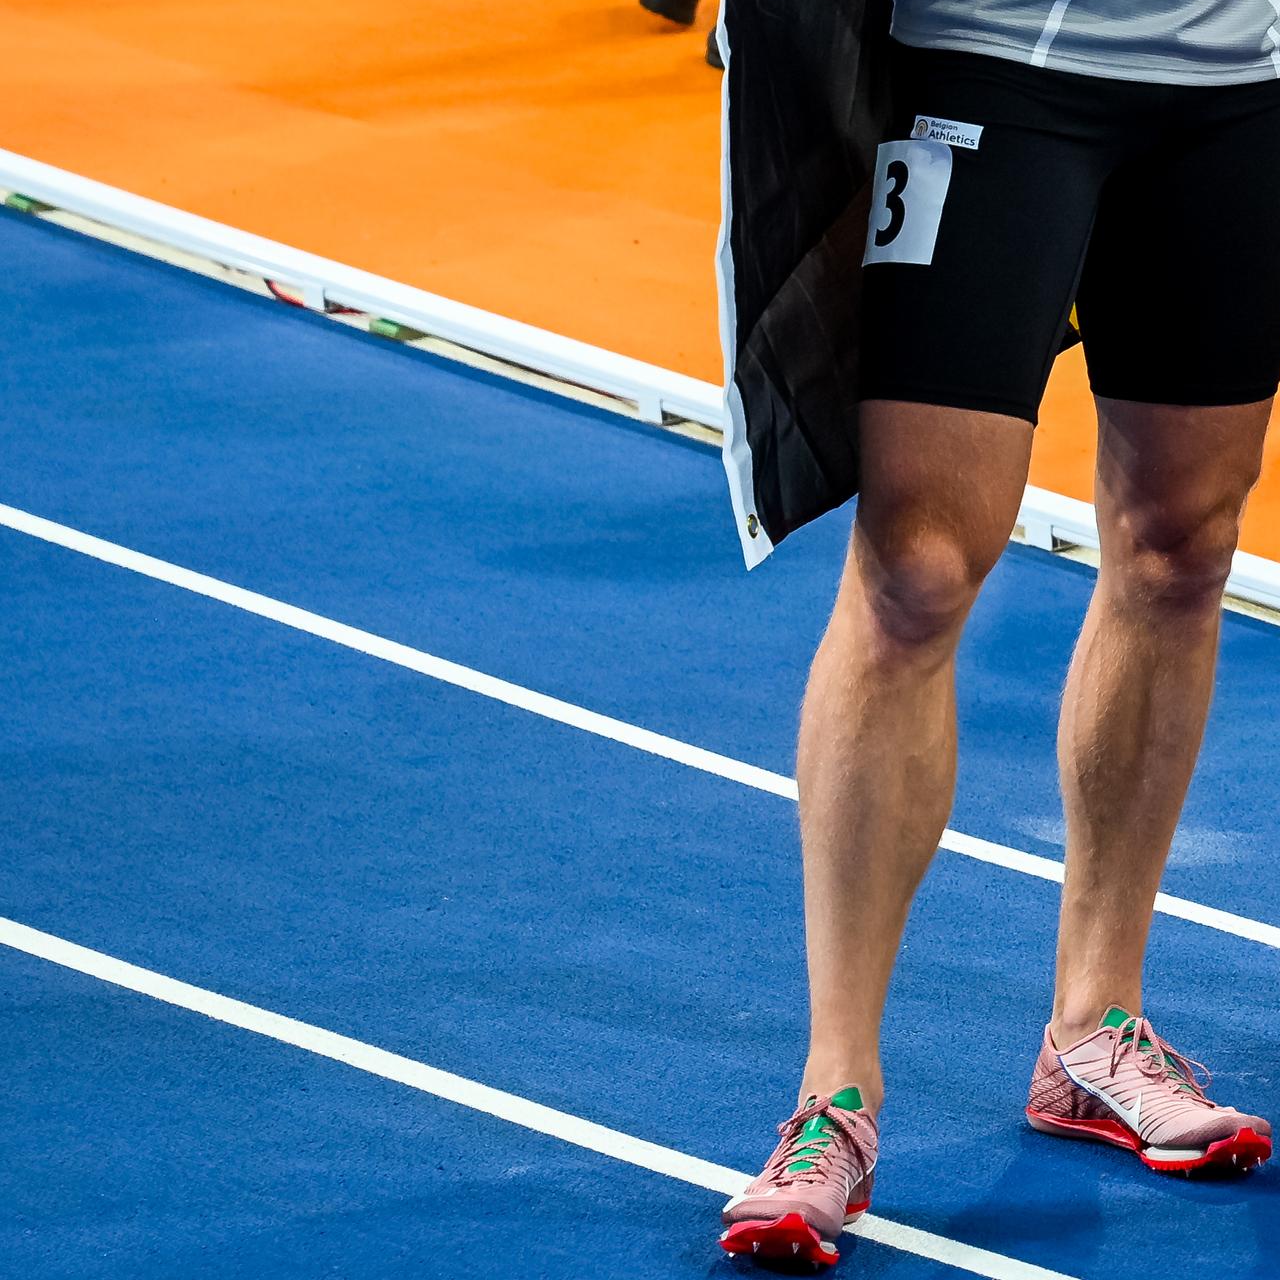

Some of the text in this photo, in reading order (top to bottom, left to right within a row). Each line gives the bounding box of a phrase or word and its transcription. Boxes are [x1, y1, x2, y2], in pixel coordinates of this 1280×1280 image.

[930, 120, 959, 132] Belgian
[928, 129, 976, 147] Athletics
[874, 160, 910, 248] 3
